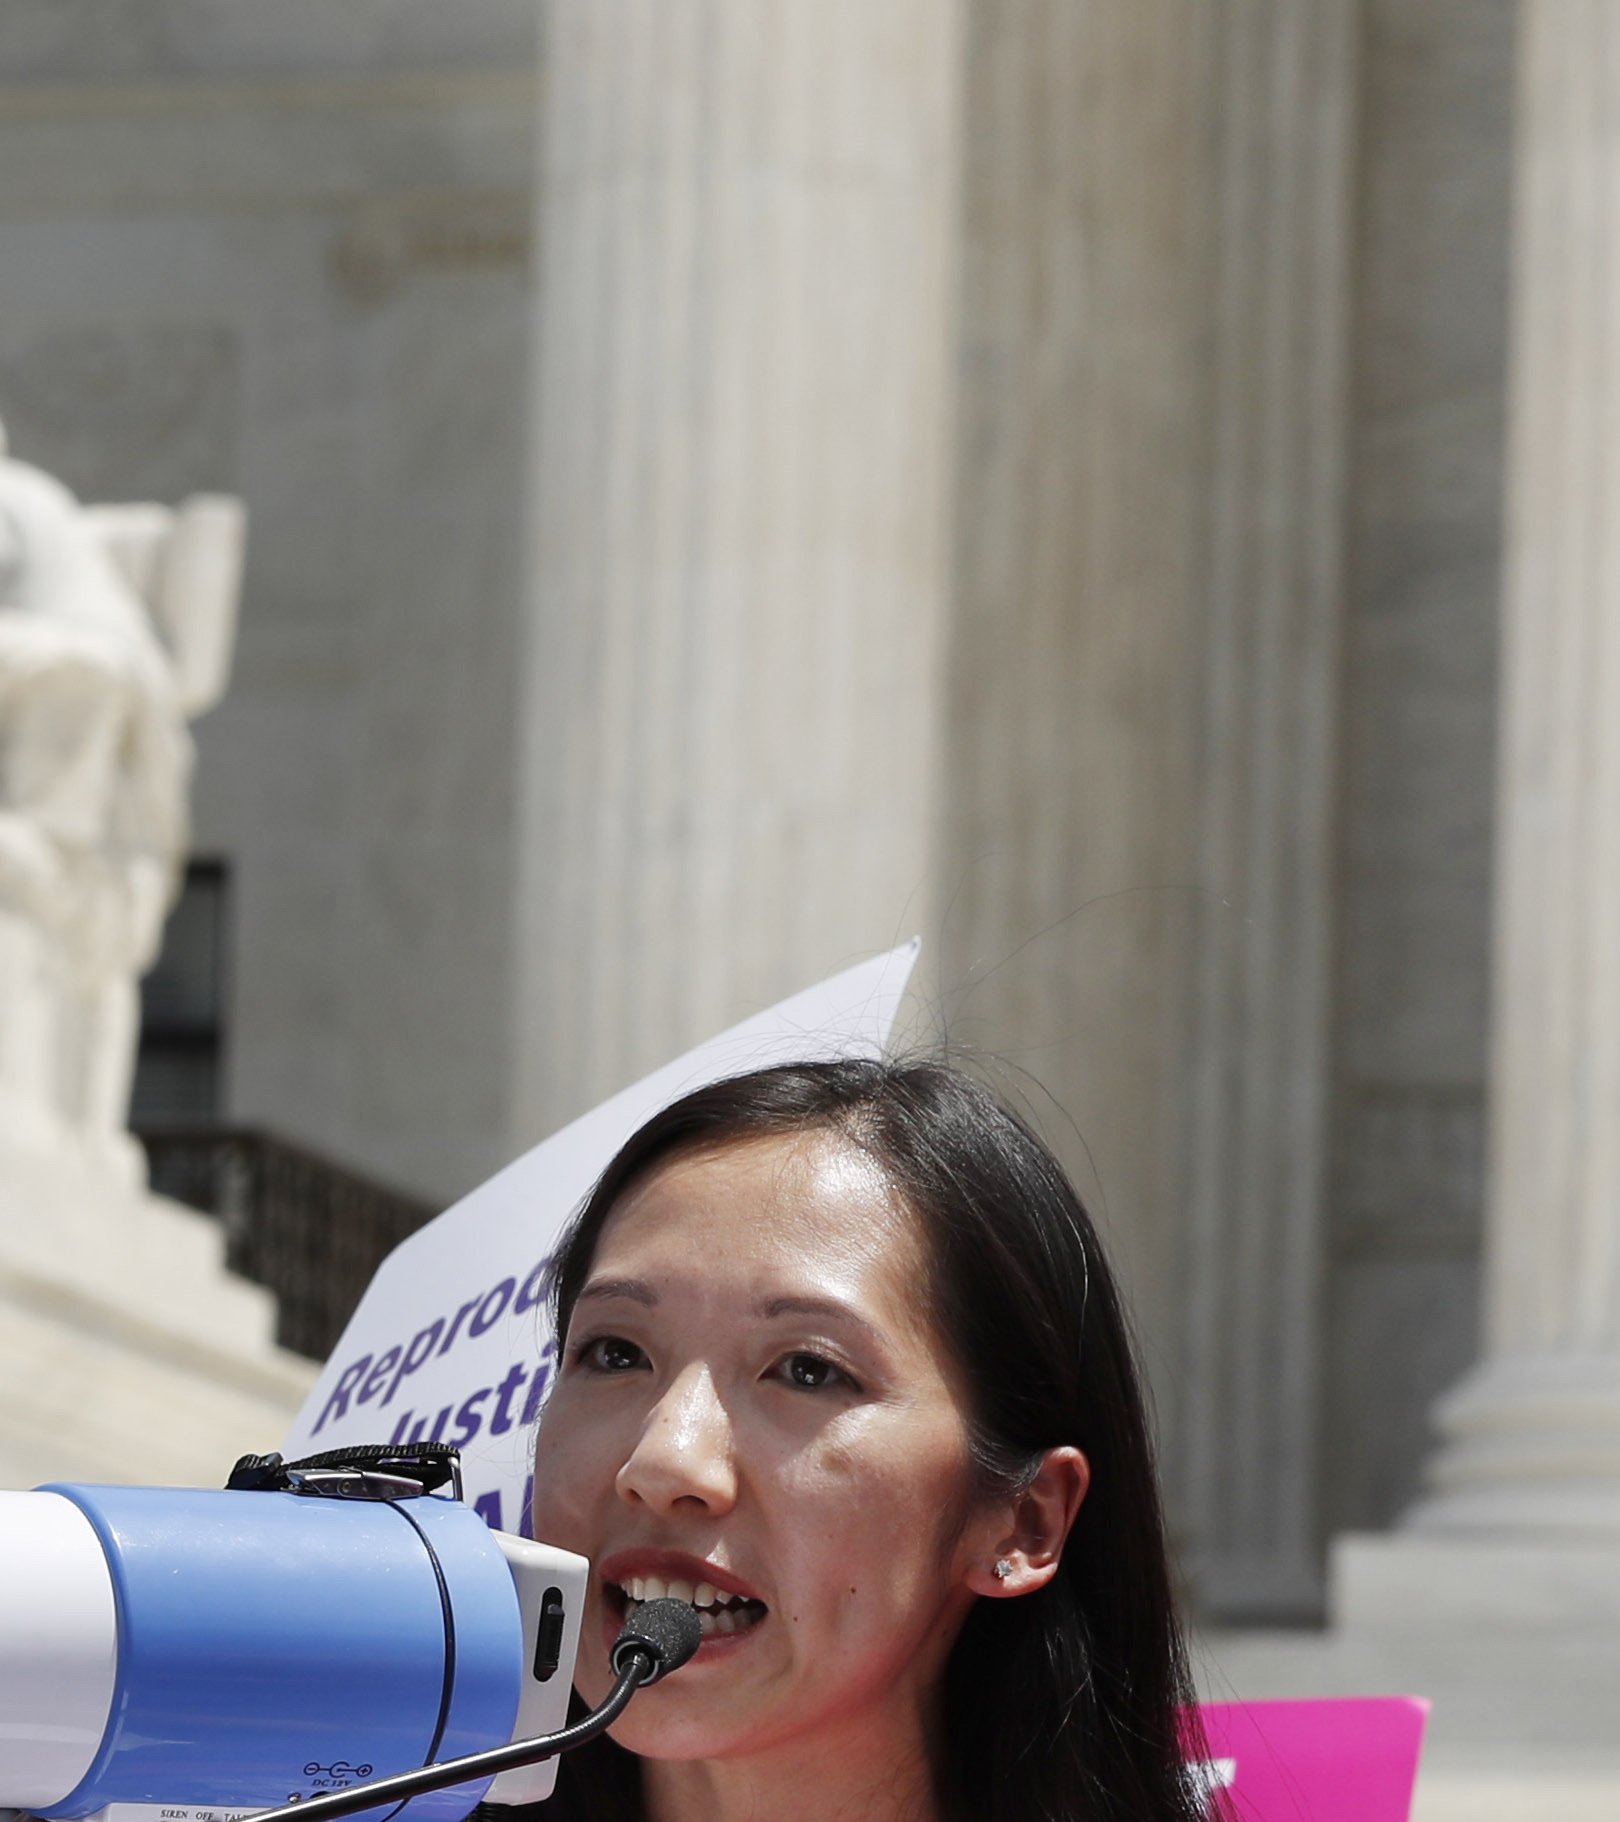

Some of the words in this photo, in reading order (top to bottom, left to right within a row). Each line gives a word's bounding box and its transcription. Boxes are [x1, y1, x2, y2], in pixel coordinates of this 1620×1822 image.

[312, 1778, 329, 1787] DC
[332, 1778, 352, 1787] 12V
[161, 1809, 188, 1819] SIREN
[196, 1811, 214, 1821] OFF
